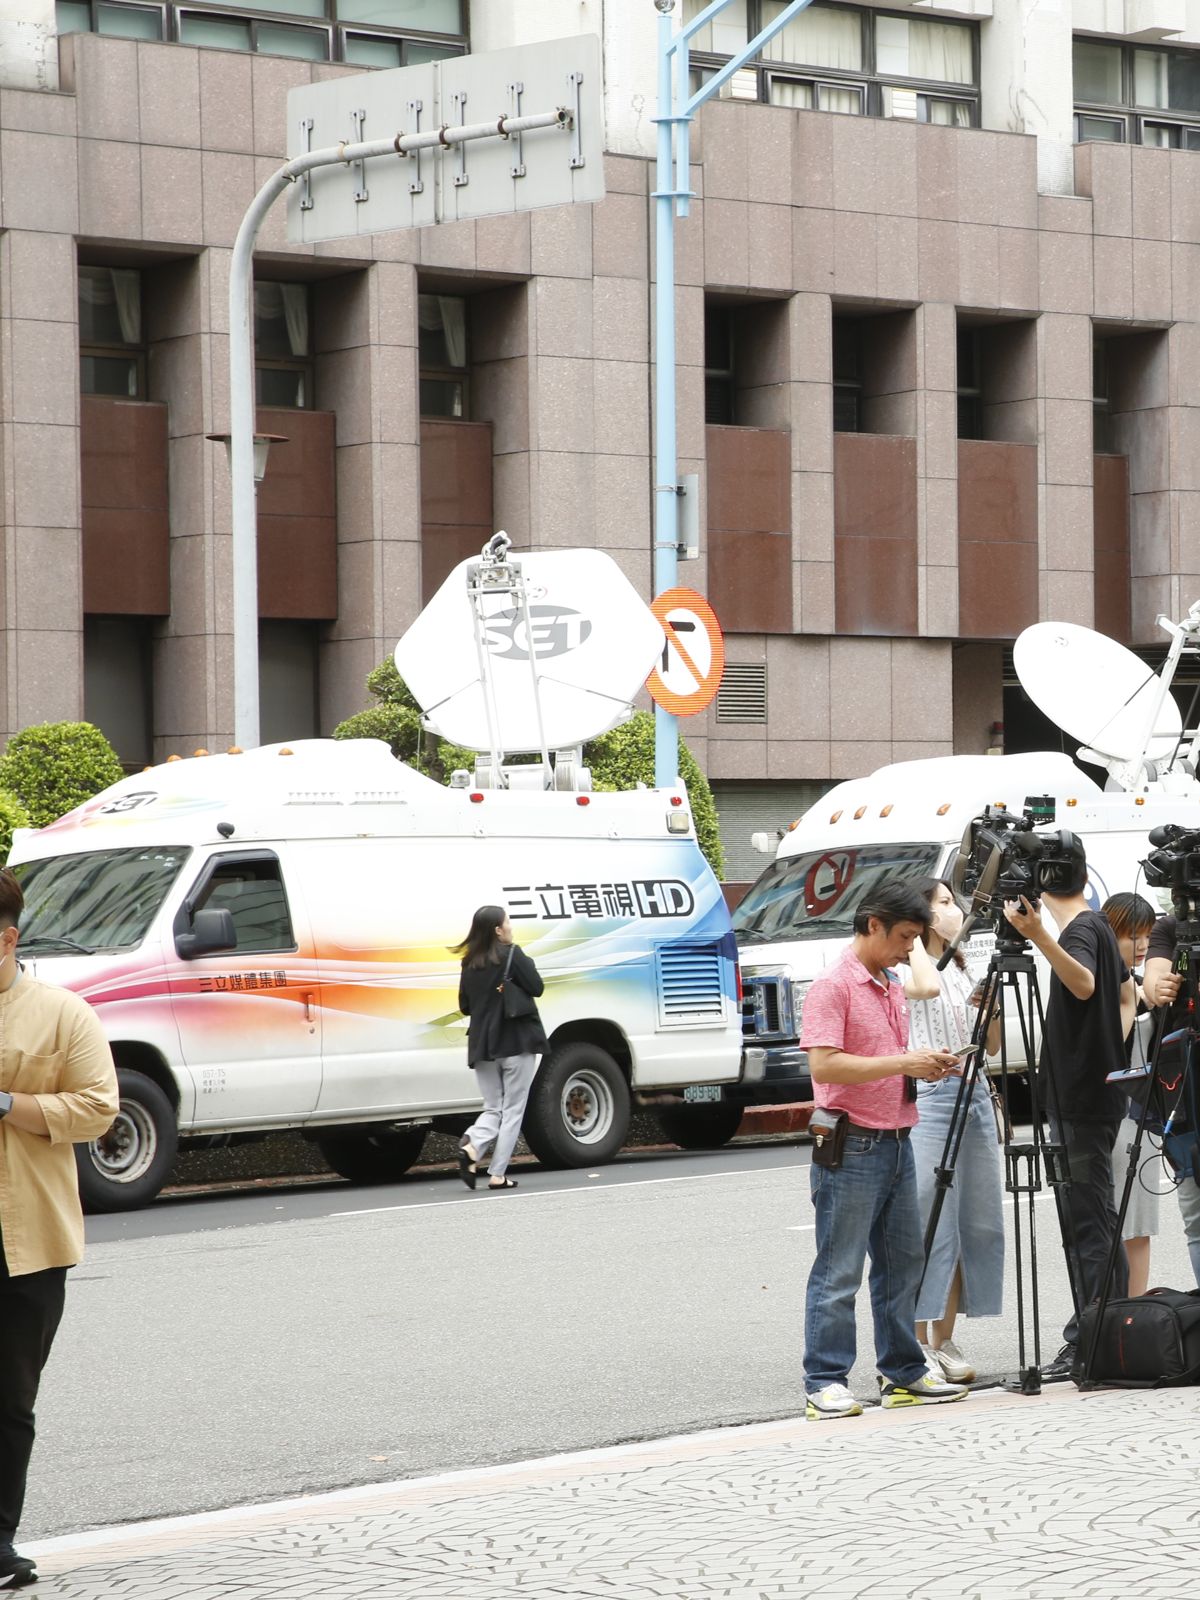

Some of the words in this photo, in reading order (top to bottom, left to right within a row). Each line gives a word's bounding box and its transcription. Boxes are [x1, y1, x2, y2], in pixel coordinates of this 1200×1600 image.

[199, 970, 287, 992] 三立媒體集團
